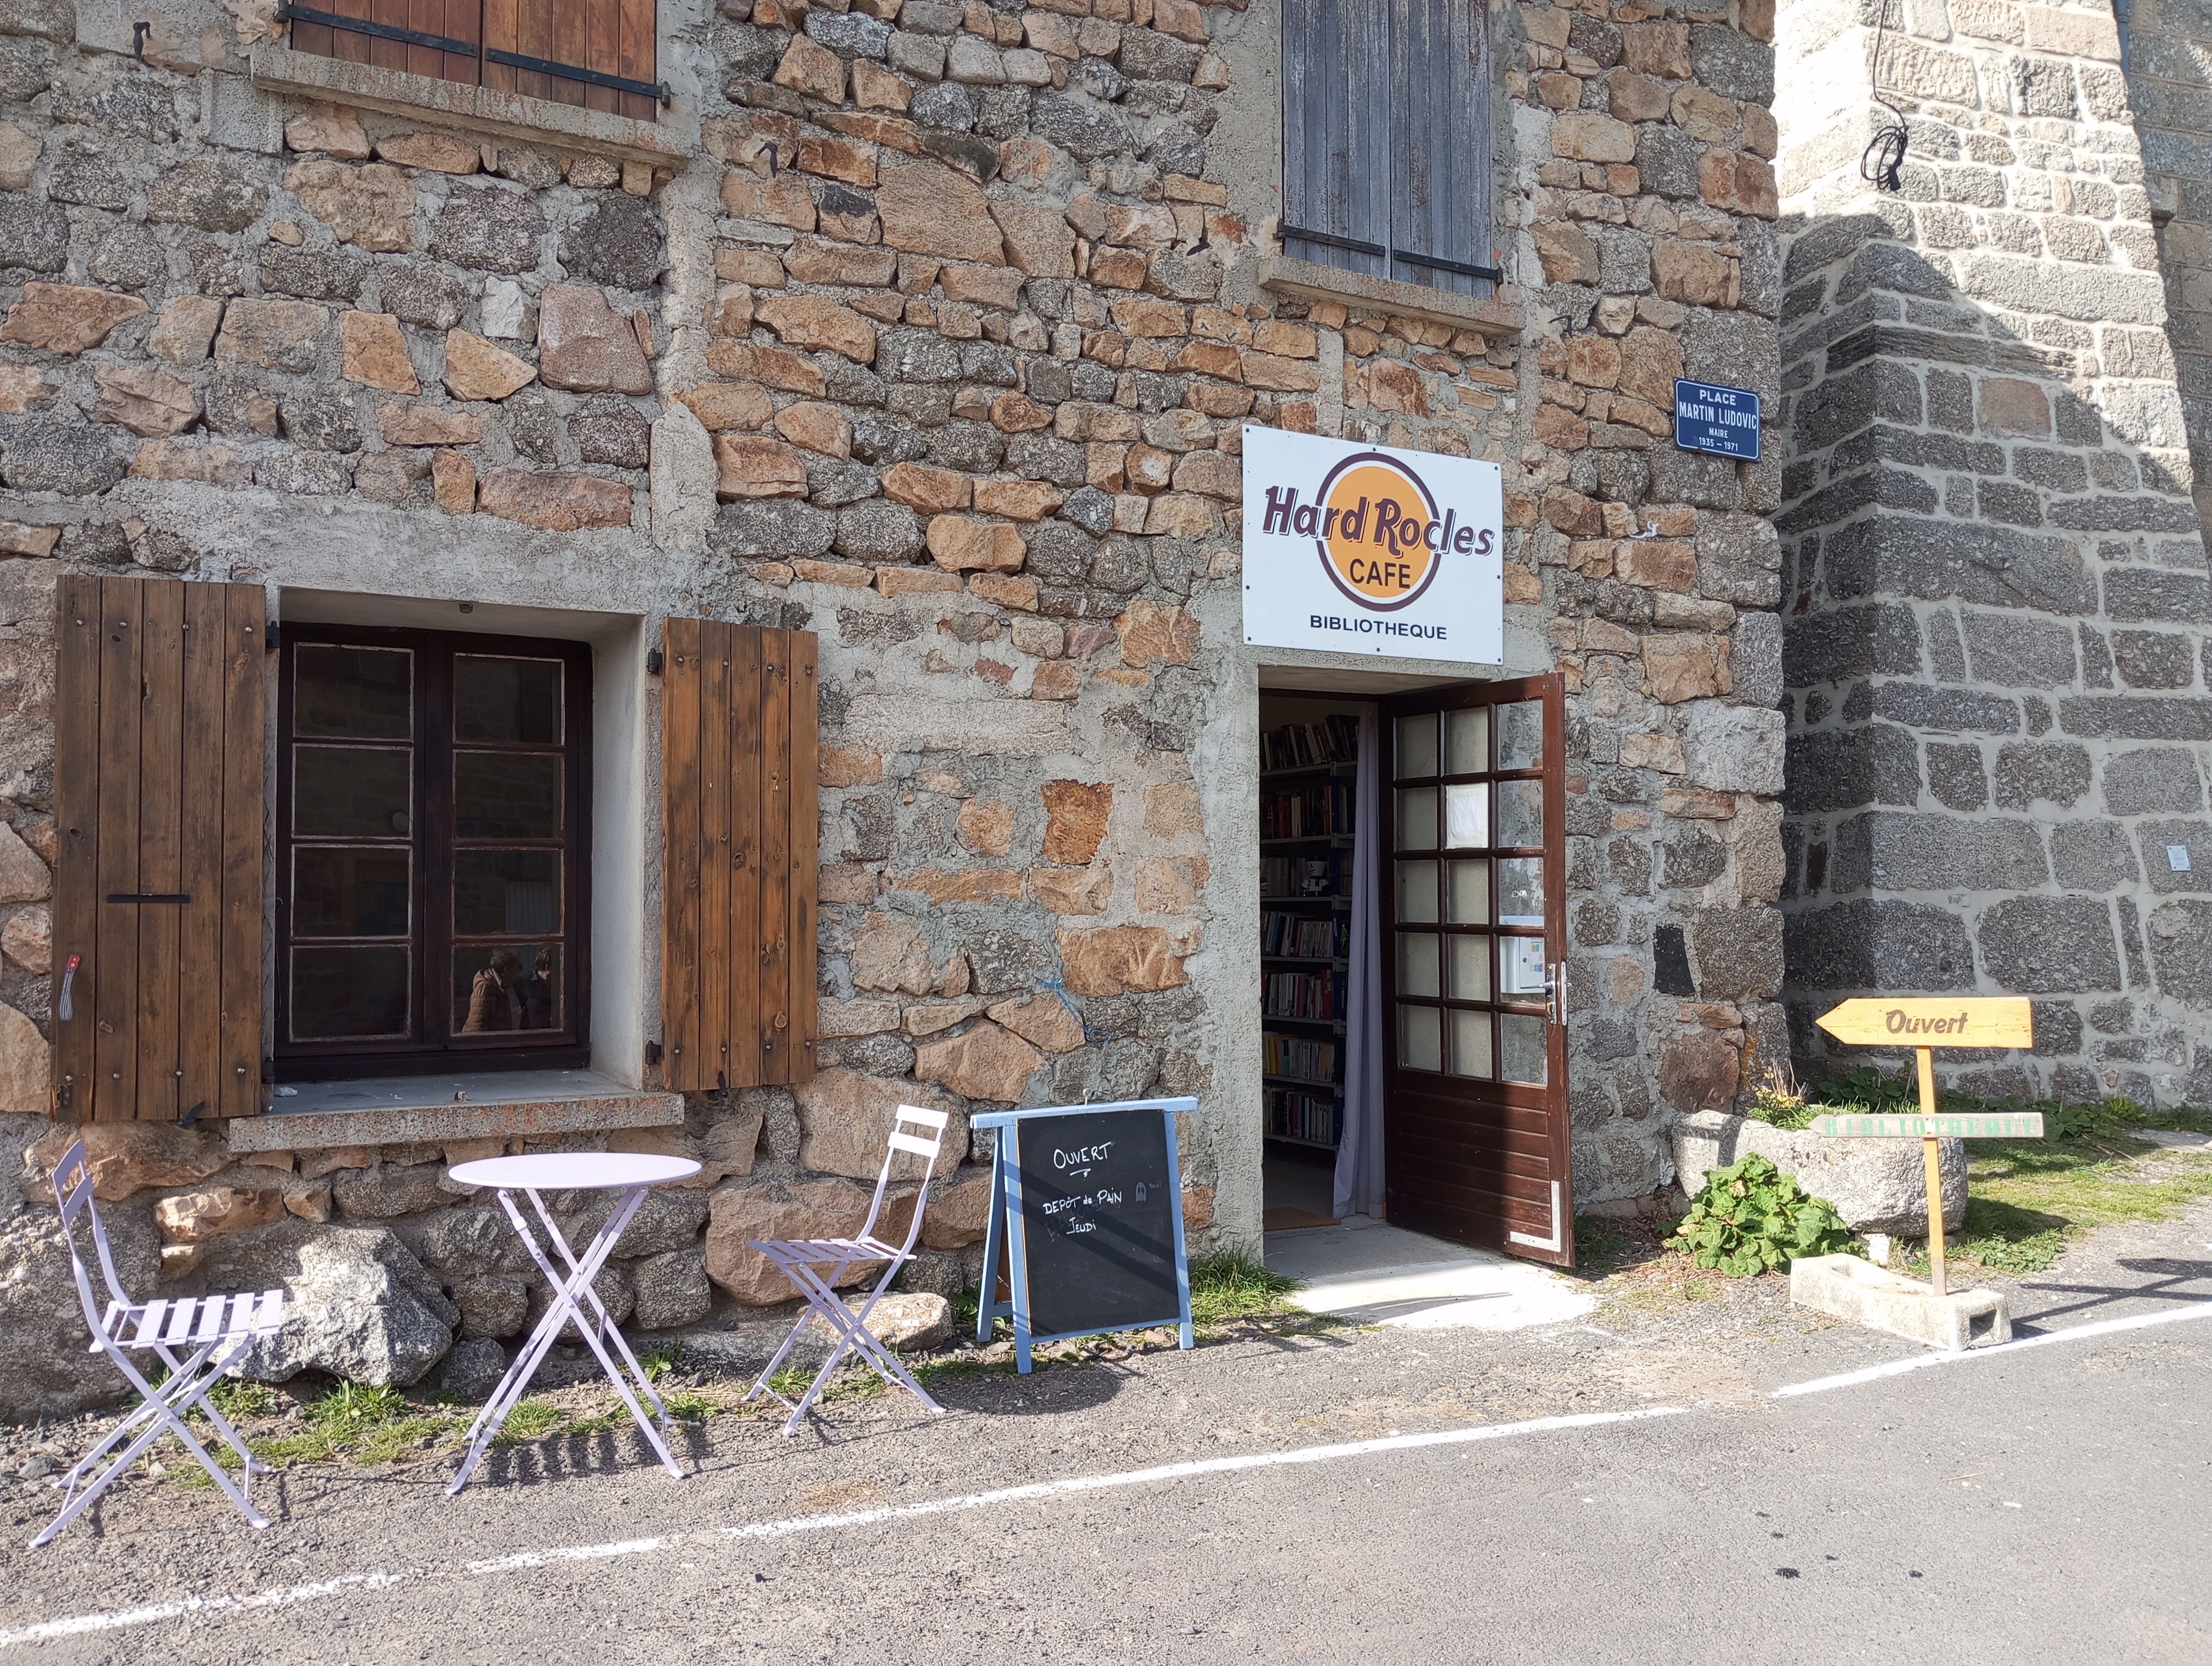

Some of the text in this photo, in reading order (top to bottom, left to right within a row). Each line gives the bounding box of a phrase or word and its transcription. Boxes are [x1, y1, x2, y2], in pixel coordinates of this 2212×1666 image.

[1699, 389, 1737, 406] PLACE
[1679, 401, 1757, 430] MARTIN LUDOVIC
[1699, 437, 1714, 447] 1935
[1724, 441, 1738, 452] 1971
[1708, 427, 1728, 439] MAIRE
[1262, 485, 1495, 559] Hard Rocles
[1349, 558, 1411, 589] CAFE
[1310, 615, 1448, 640] BIBLIOTHEQUE
[1886, 1009, 1968, 1034] Ouvert
[1053, 1141, 1113, 1169] OUVERT
[1083, 1195, 1092, 1204] de
